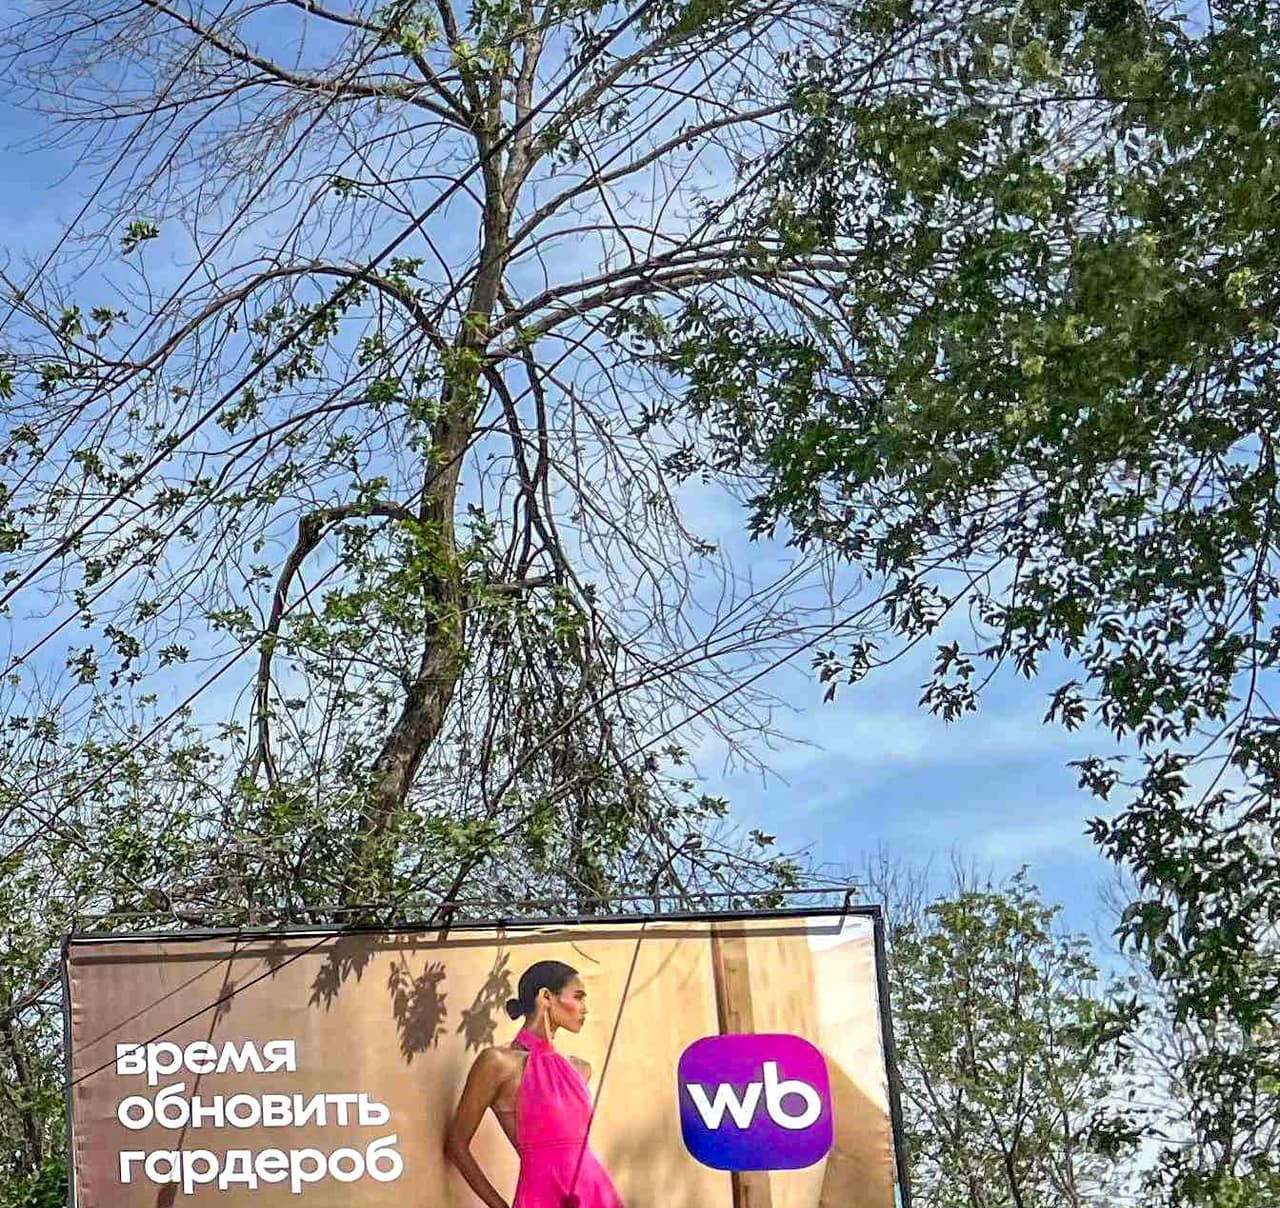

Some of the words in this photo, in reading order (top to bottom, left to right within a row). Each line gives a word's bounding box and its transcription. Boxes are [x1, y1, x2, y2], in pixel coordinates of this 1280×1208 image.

[115, 1040, 297, 1087] время
[117, 1082, 391, 1130] обновить
[686, 1060, 822, 1131] wb
[119, 1134, 404, 1194] гардероб
